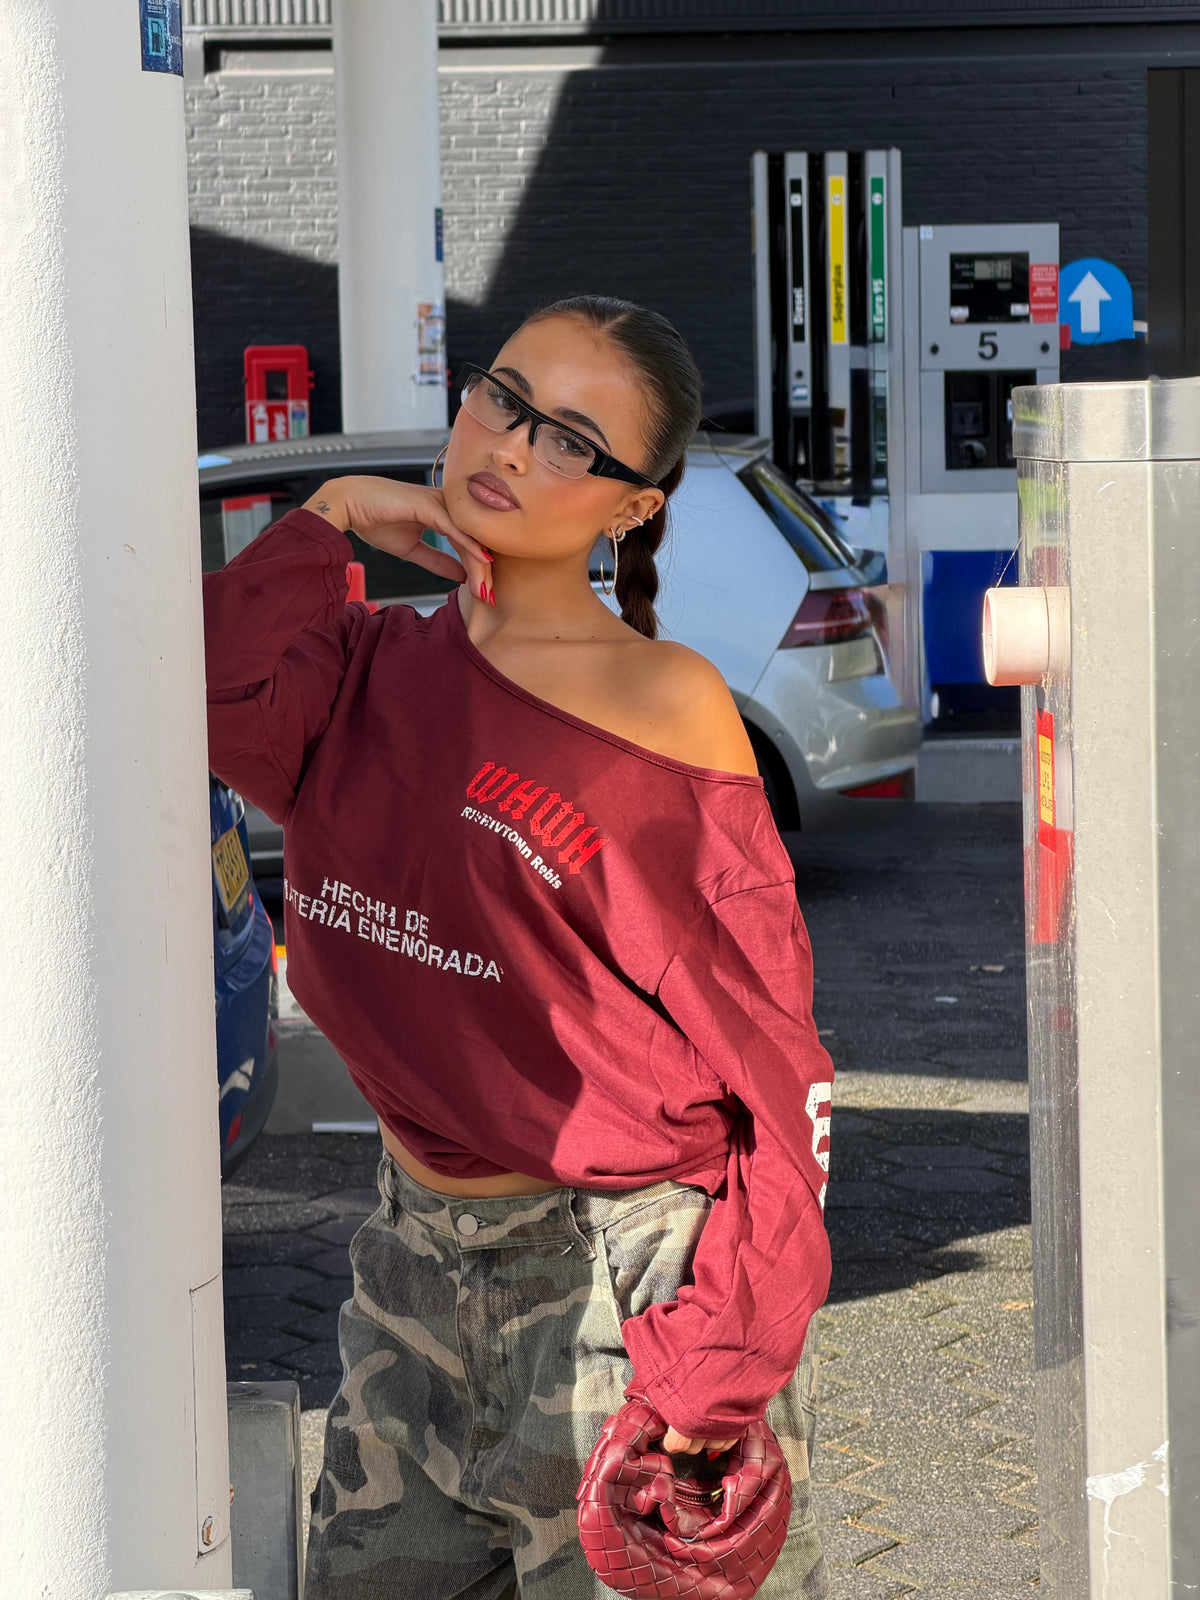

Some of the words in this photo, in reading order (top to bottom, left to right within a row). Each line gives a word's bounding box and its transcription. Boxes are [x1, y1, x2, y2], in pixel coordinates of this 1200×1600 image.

[833, 264, 844, 322] Superplus
[872, 278, 883, 294] 95
[793, 287, 804, 325] Diesel
[873, 295, 884, 324] Euro
[978, 331, 999, 361] 5
[405, 909, 430, 940] DE
[358, 916, 502, 983] ENENORADA
